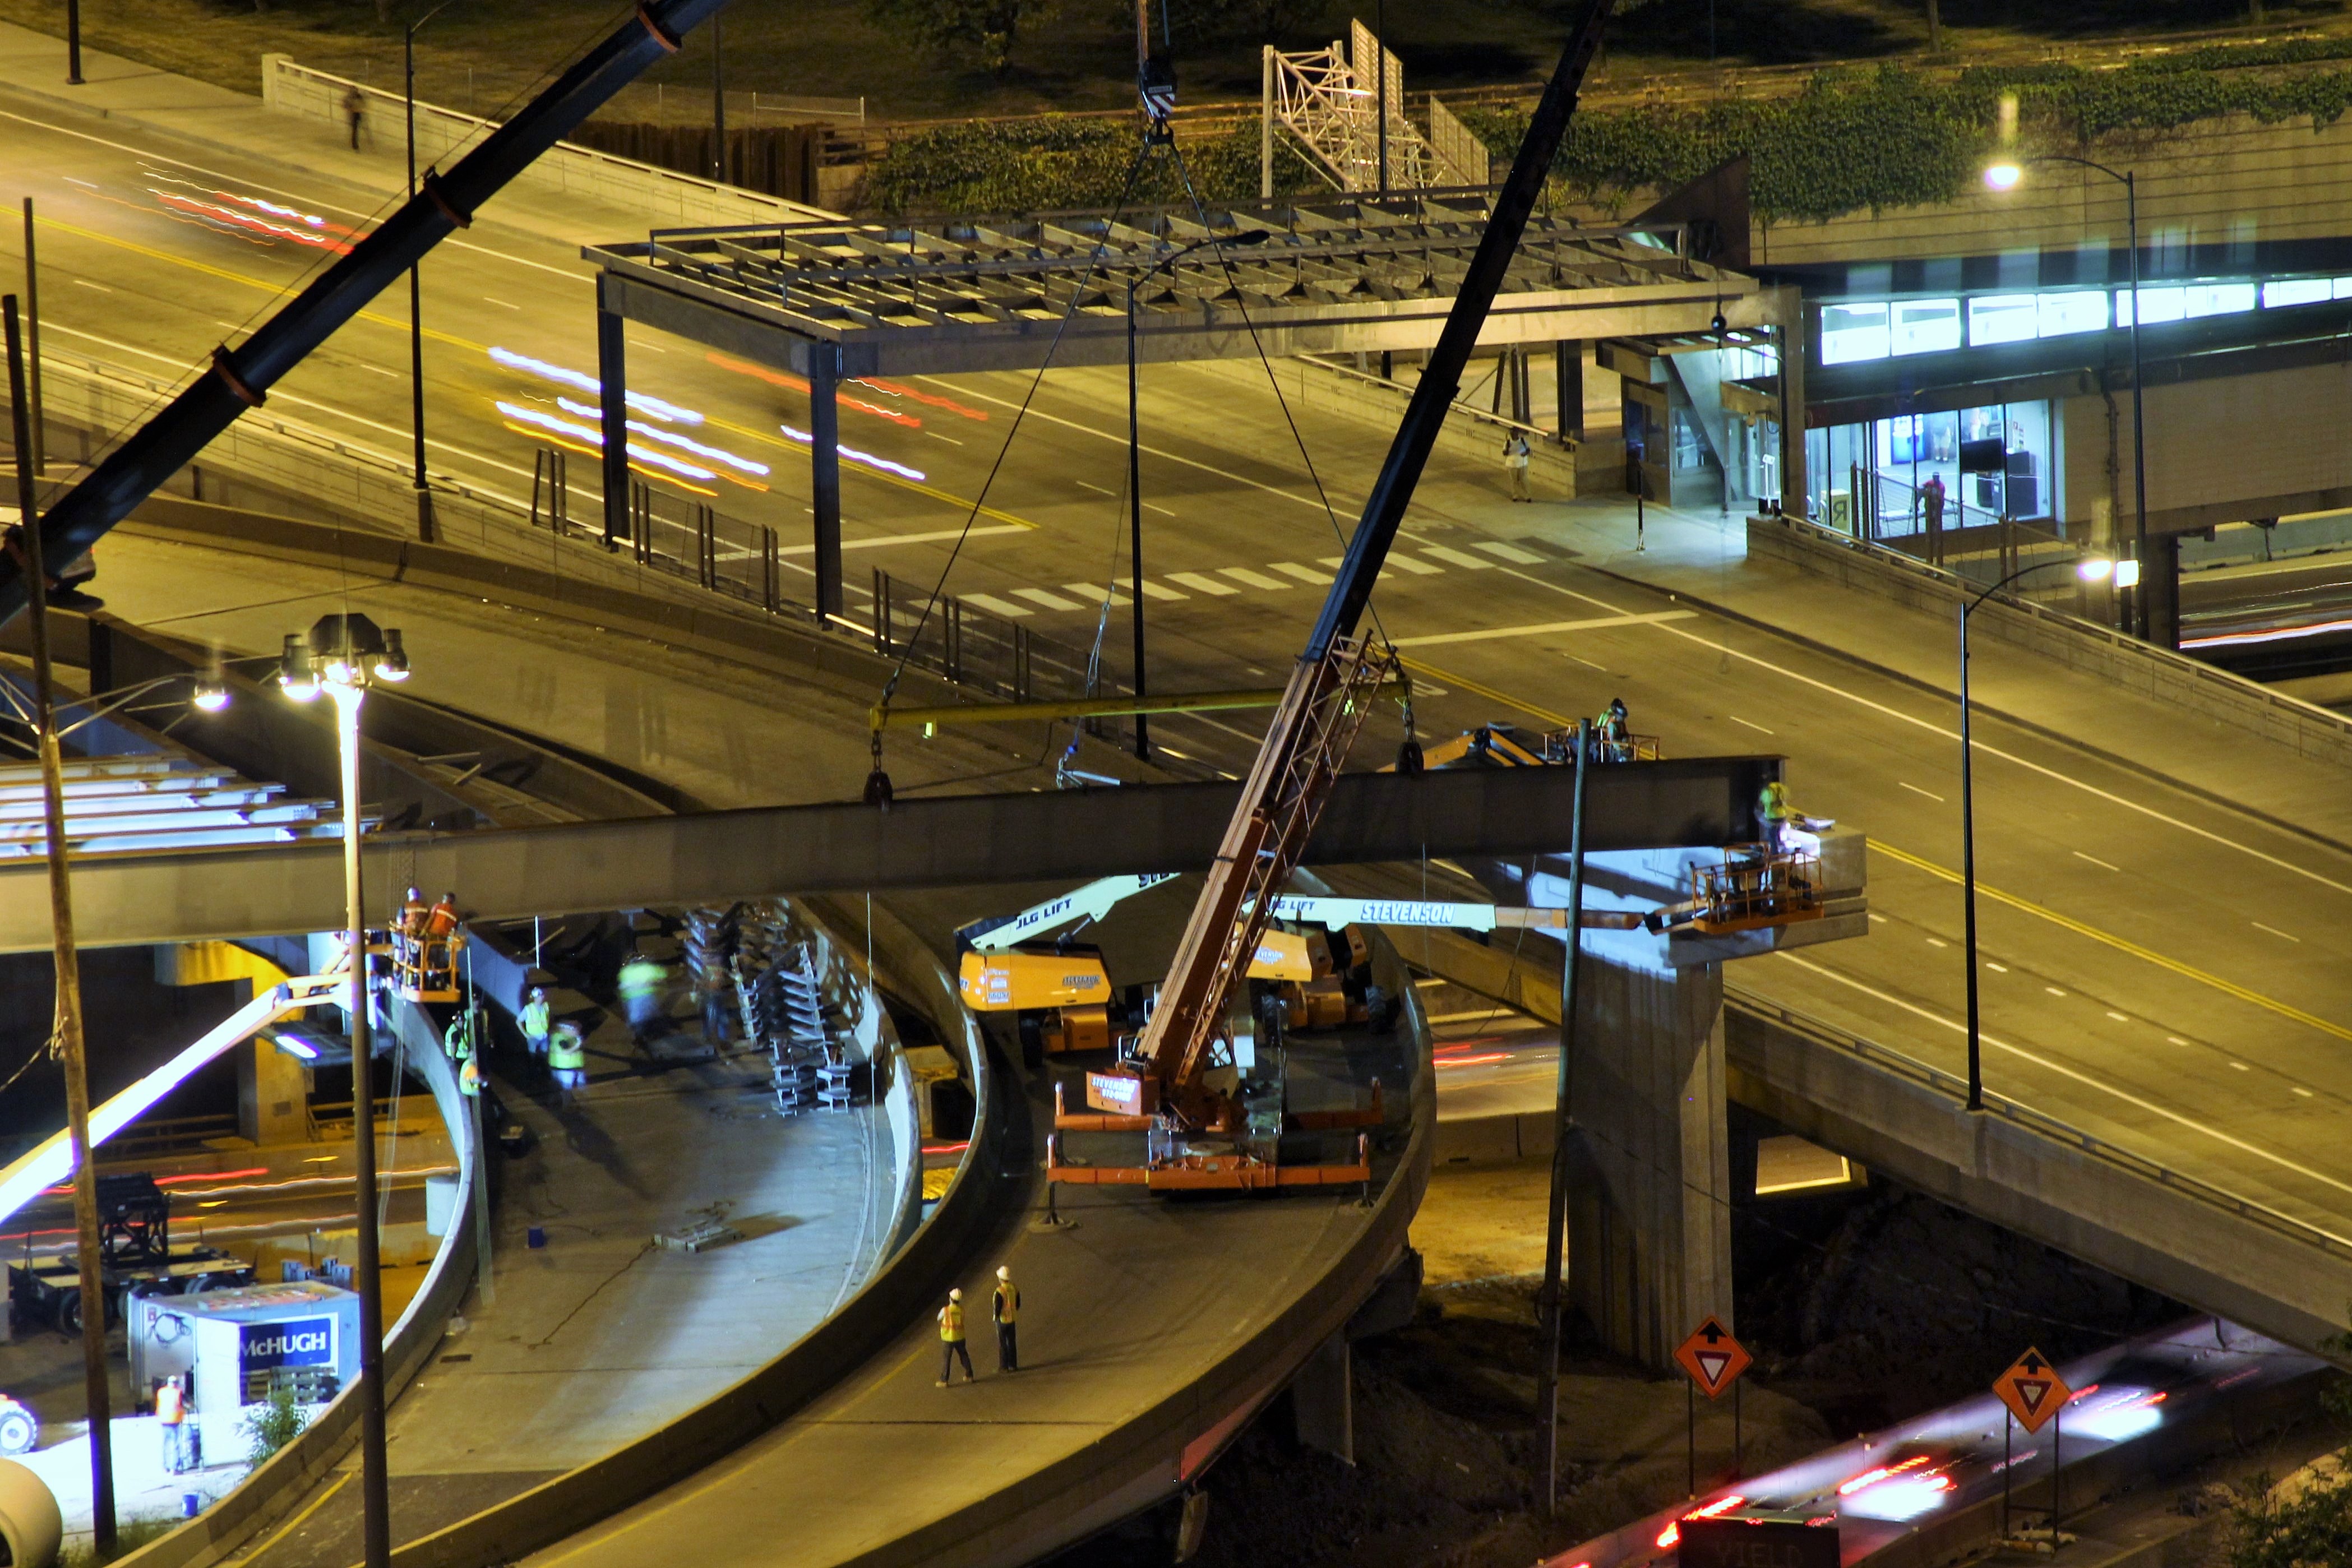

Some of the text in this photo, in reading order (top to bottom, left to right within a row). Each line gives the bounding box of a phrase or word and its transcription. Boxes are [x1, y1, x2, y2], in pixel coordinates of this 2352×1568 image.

[1016, 898, 1072, 930] JLG LIFT
[1290, 900, 1315, 911] LIFT
[1361, 901, 1454, 924] STEVENSON
[241, 1331, 327, 1357] McHUGH
